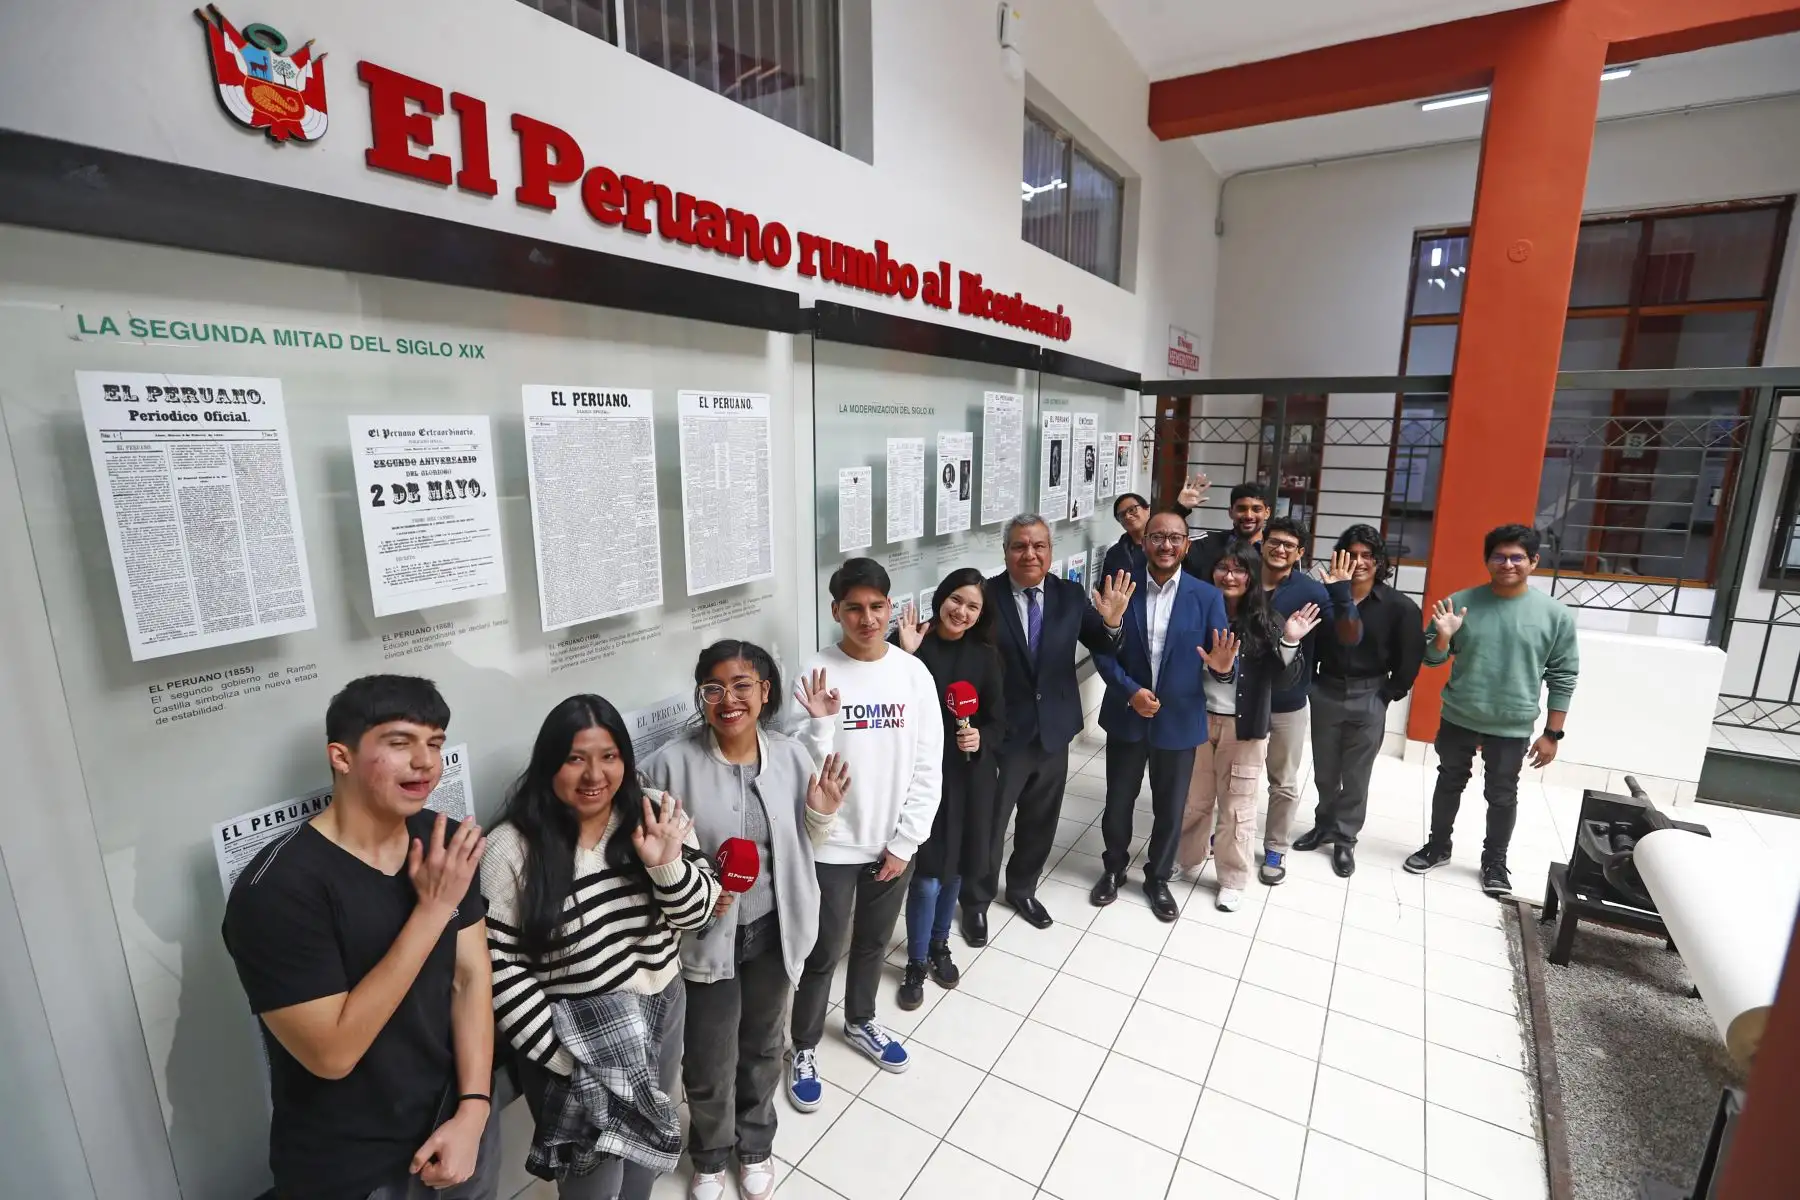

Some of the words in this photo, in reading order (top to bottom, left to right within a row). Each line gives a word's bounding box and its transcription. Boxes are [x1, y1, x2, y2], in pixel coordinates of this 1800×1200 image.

[357, 60, 498, 196] El
[510, 113, 792, 268] Peruano
[797, 231, 919, 300] rumbo
[921, 261, 952, 310] al
[958, 270, 1072, 342] Bicentenario
[77, 314, 120, 336] LA
[128, 318, 266, 345] SEGUNDA
[273, 328, 343, 349] MITAD
[350, 335, 391, 353] DEL
[396, 338, 453, 357] SIGLO
[458, 343, 485, 360] XIX
[103, 384, 139, 402] EL
[145, 385, 266, 405] PERUANO.
[551, 391, 567, 407] EL
[572, 392, 631, 408] PERUANO.
[699, 396, 709, 409] EL
[713, 397, 753, 410] PERUANO.
[128, 410, 198, 422] Periodico
[203, 411, 251, 422] Oficial.
[839, 404, 848, 413] LA
[900, 406, 910, 414] DEL
[911, 406, 928, 415] SIGLO
[368, 429, 380, 438] El
[382, 429, 416, 439] Peruano
[374, 458, 416, 468] SEGUNDO
[420, 456, 477, 465] ANIVERSARIO
[370, 484, 385, 507] 2
[391, 482, 421, 504] DE
[427, 478, 486, 501] MAYO.
[394, 626, 432, 639] PERUANO
[149, 686, 164, 694] EL
[167, 672, 222, 690] PERUANO
[224, 666, 254, 680] (1855)
[151, 695, 161, 704] El
[171, 686, 213, 700] segundo
[221, 675, 261, 691] gobierno
[268, 670, 279, 679] de
[153, 699, 191, 714] Castilla
[195, 689, 239, 706] simboliza
[244, 684, 260, 694] una
[265, 678, 291, 690] nueva
[295, 672, 318, 683] etapa
[156, 717, 168, 726] de
[172, 703, 226, 722] estabilidad.
[636, 716, 648, 728] EL
[652, 702, 688, 723] PERUANO.
[842, 704, 906, 720] TOMMY
[869, 718, 905, 729] JEANS
[222, 827, 243, 842] EL
[251, 794, 333, 832] PERUANO
